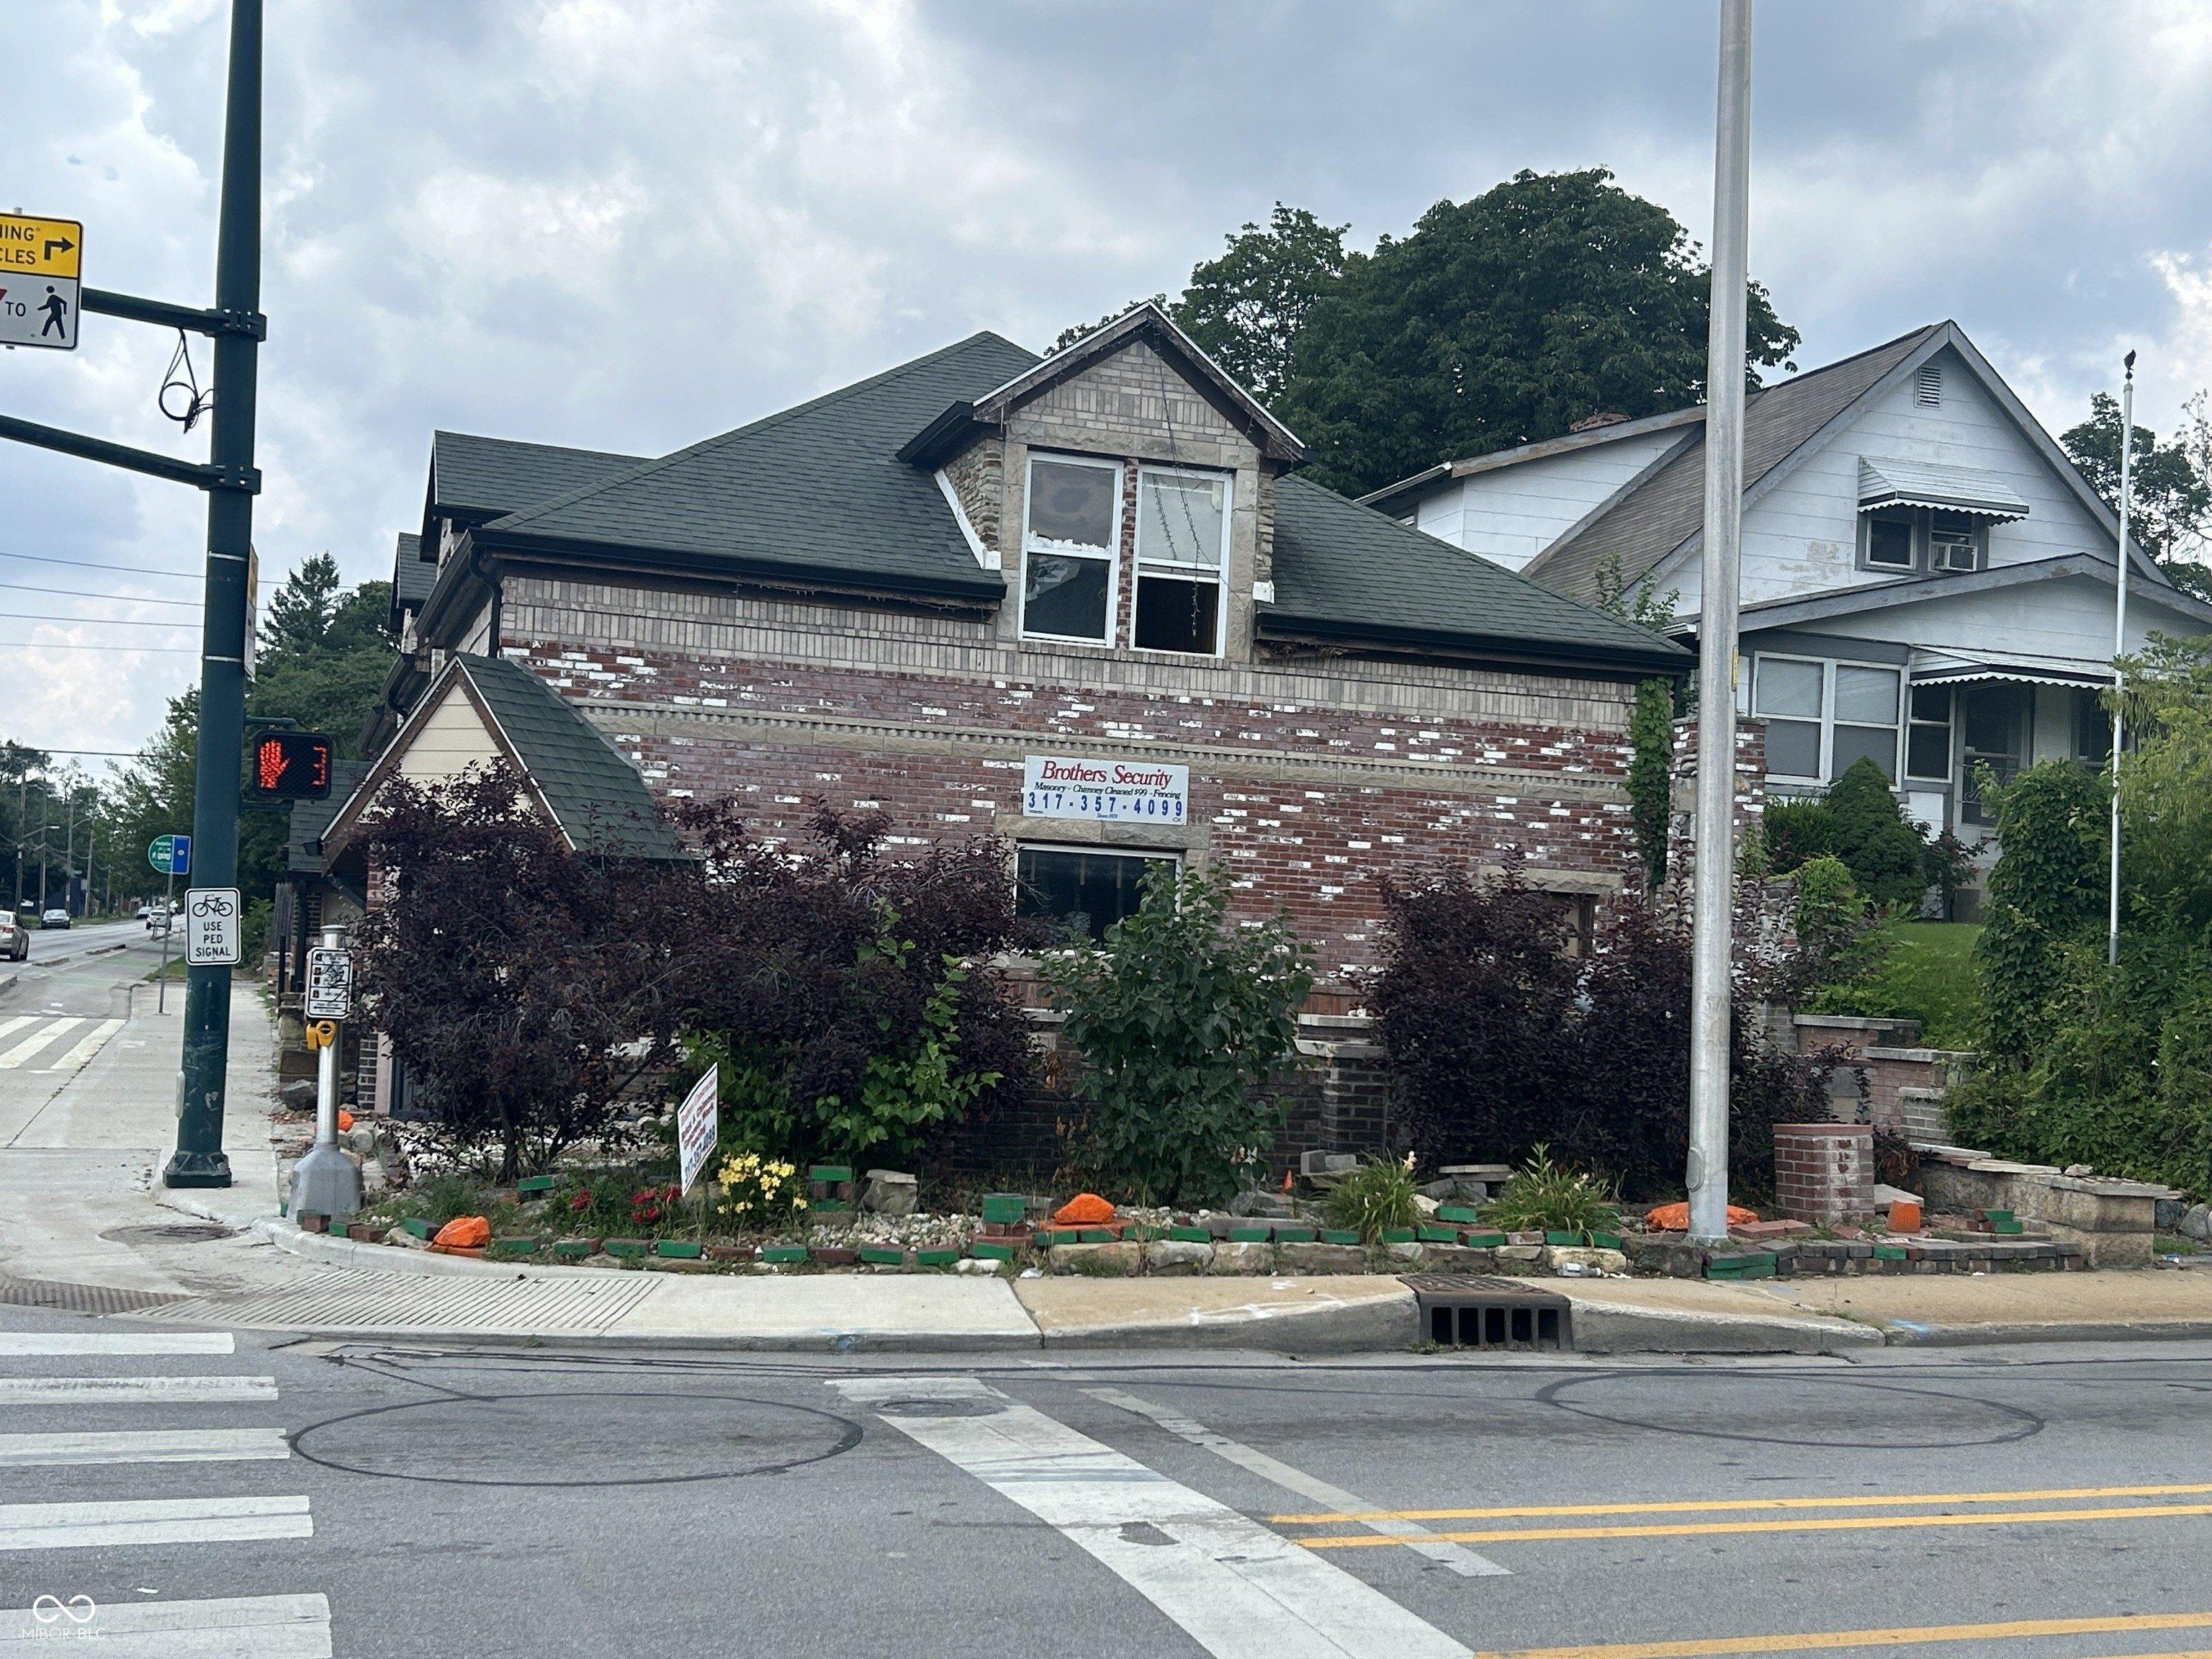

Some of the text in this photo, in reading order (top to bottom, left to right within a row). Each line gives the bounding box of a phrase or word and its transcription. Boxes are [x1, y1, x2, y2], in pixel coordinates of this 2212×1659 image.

[5, 301, 27, 317] TO
[313, 746, 327, 786] 3
[1040, 760, 1173, 790] Brothers Security
[1034, 782, 1066, 792] Masonry
[1073, 784, 1105, 795] Chimney
[1153, 789, 1182, 799] Fencing
[203, 922, 222, 931] USE
[203, 935, 223, 944] PED
[195, 947, 231, 957] SIGNAL
